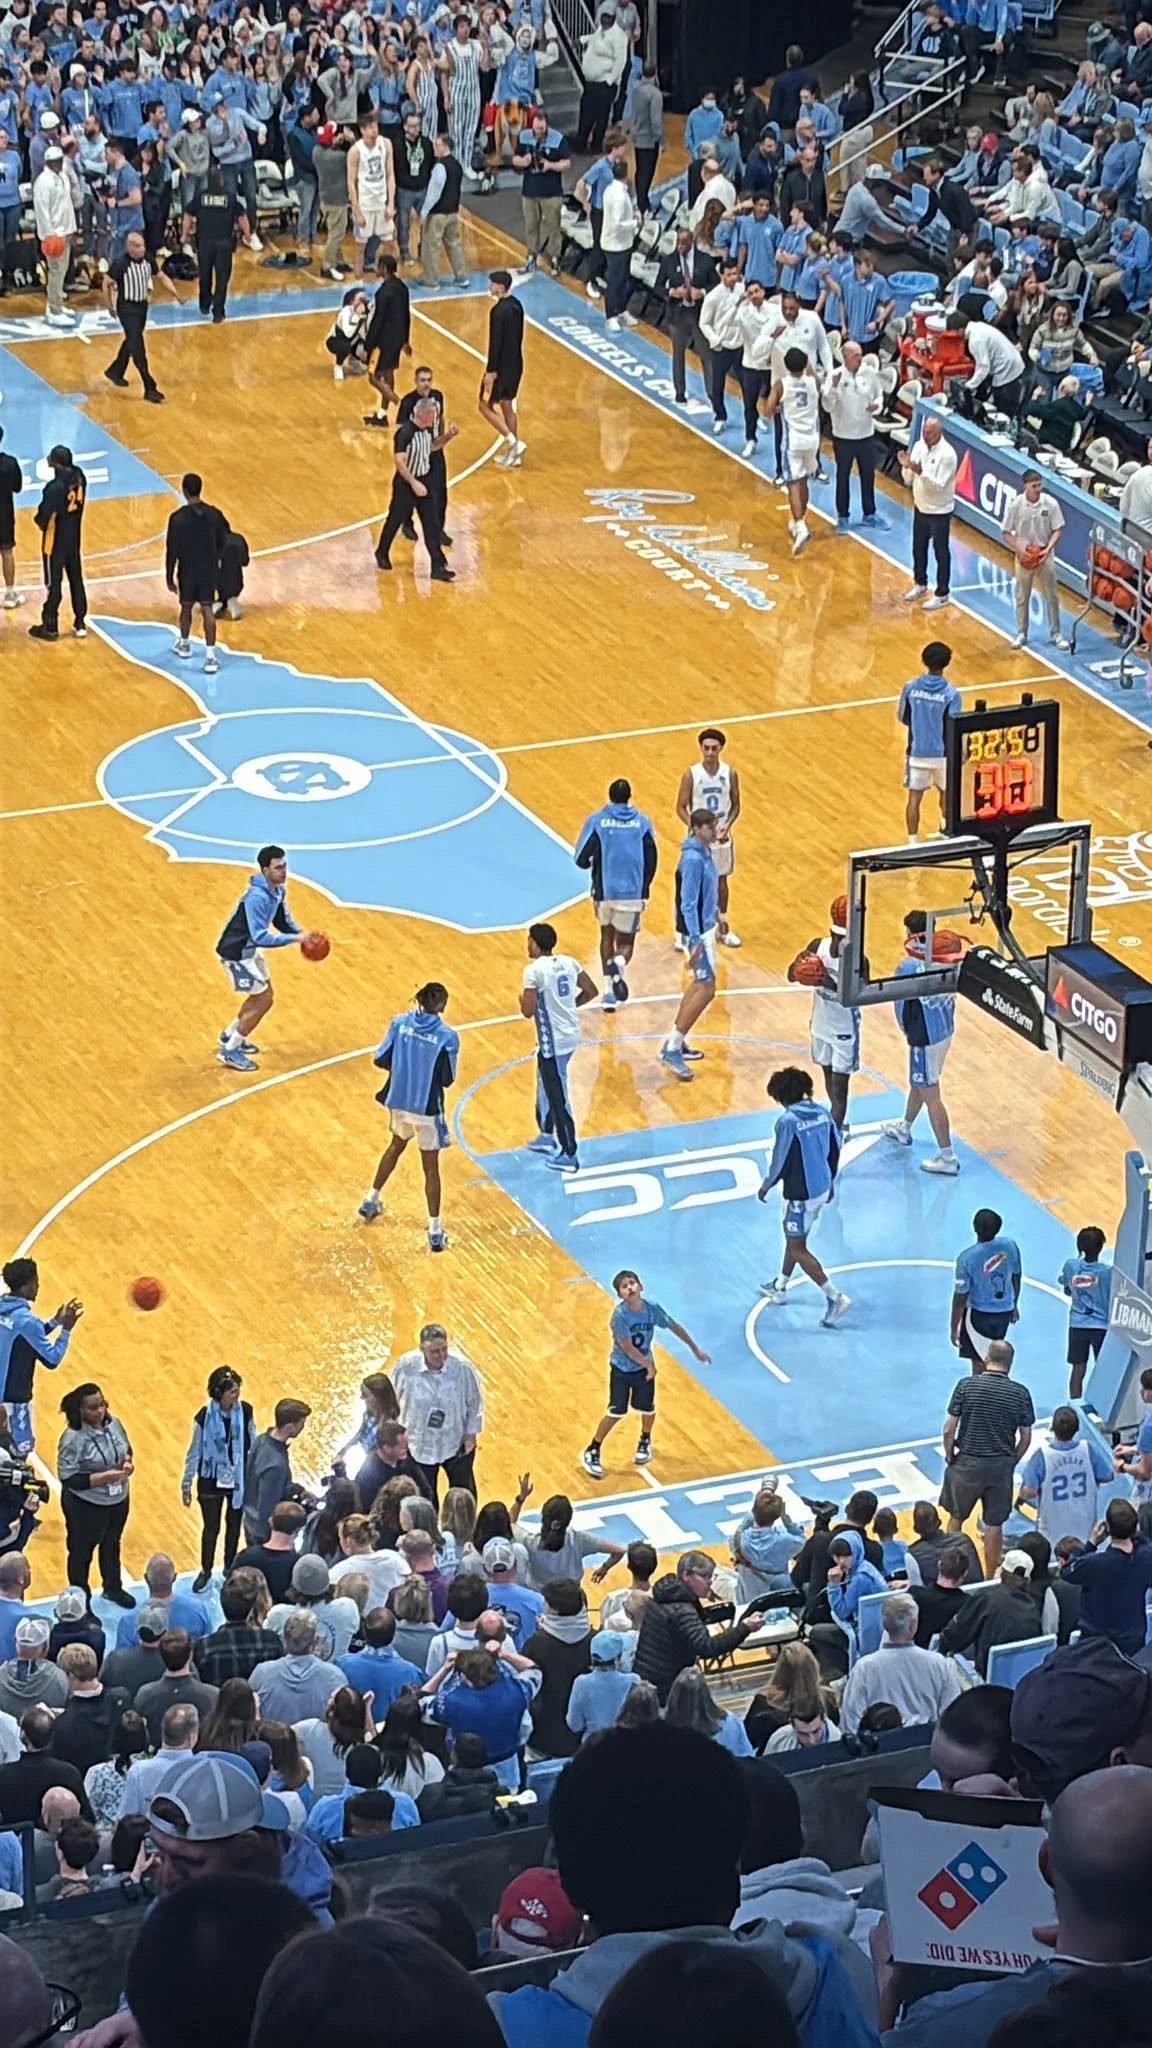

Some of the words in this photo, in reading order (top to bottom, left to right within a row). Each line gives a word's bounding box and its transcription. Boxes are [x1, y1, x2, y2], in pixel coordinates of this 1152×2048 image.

[980, 473, 1017, 523] CIT
[624, 538, 712, 591] COURT
[706, 794, 719, 811] 0
[557, 975, 570, 997] 6
[1071, 992, 1117, 1044] CITGO
[1051, 1471, 1088, 1502] 23
[957, 1946, 982, 1964] WE
[982, 1949, 1012, 1967] YES
